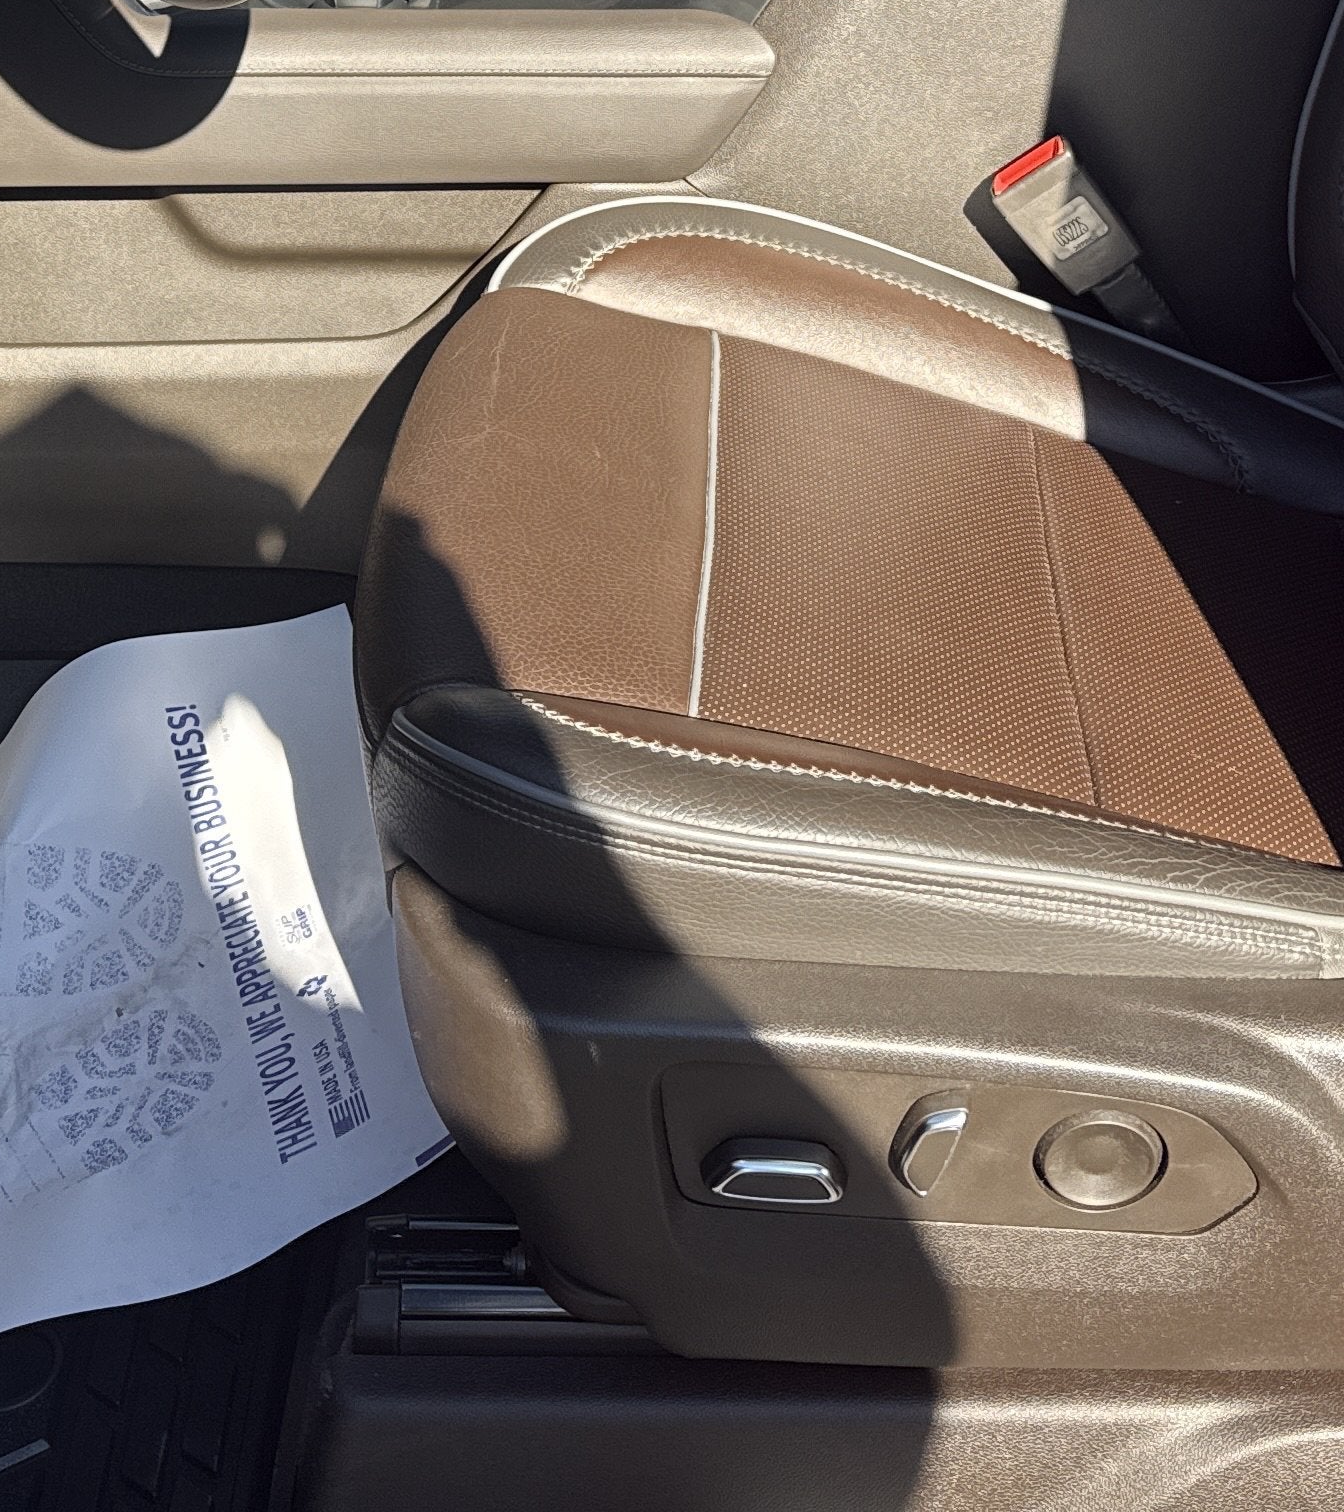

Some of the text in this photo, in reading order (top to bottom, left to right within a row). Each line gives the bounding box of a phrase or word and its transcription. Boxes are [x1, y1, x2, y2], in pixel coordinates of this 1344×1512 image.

[165, 703, 318, 1165] THANK YOU, WE APPRECIATE YOUR BUSINESS!
[295, 907, 313, 939] GRIP
[312, 1038, 343, 1106] MADE IN USA
